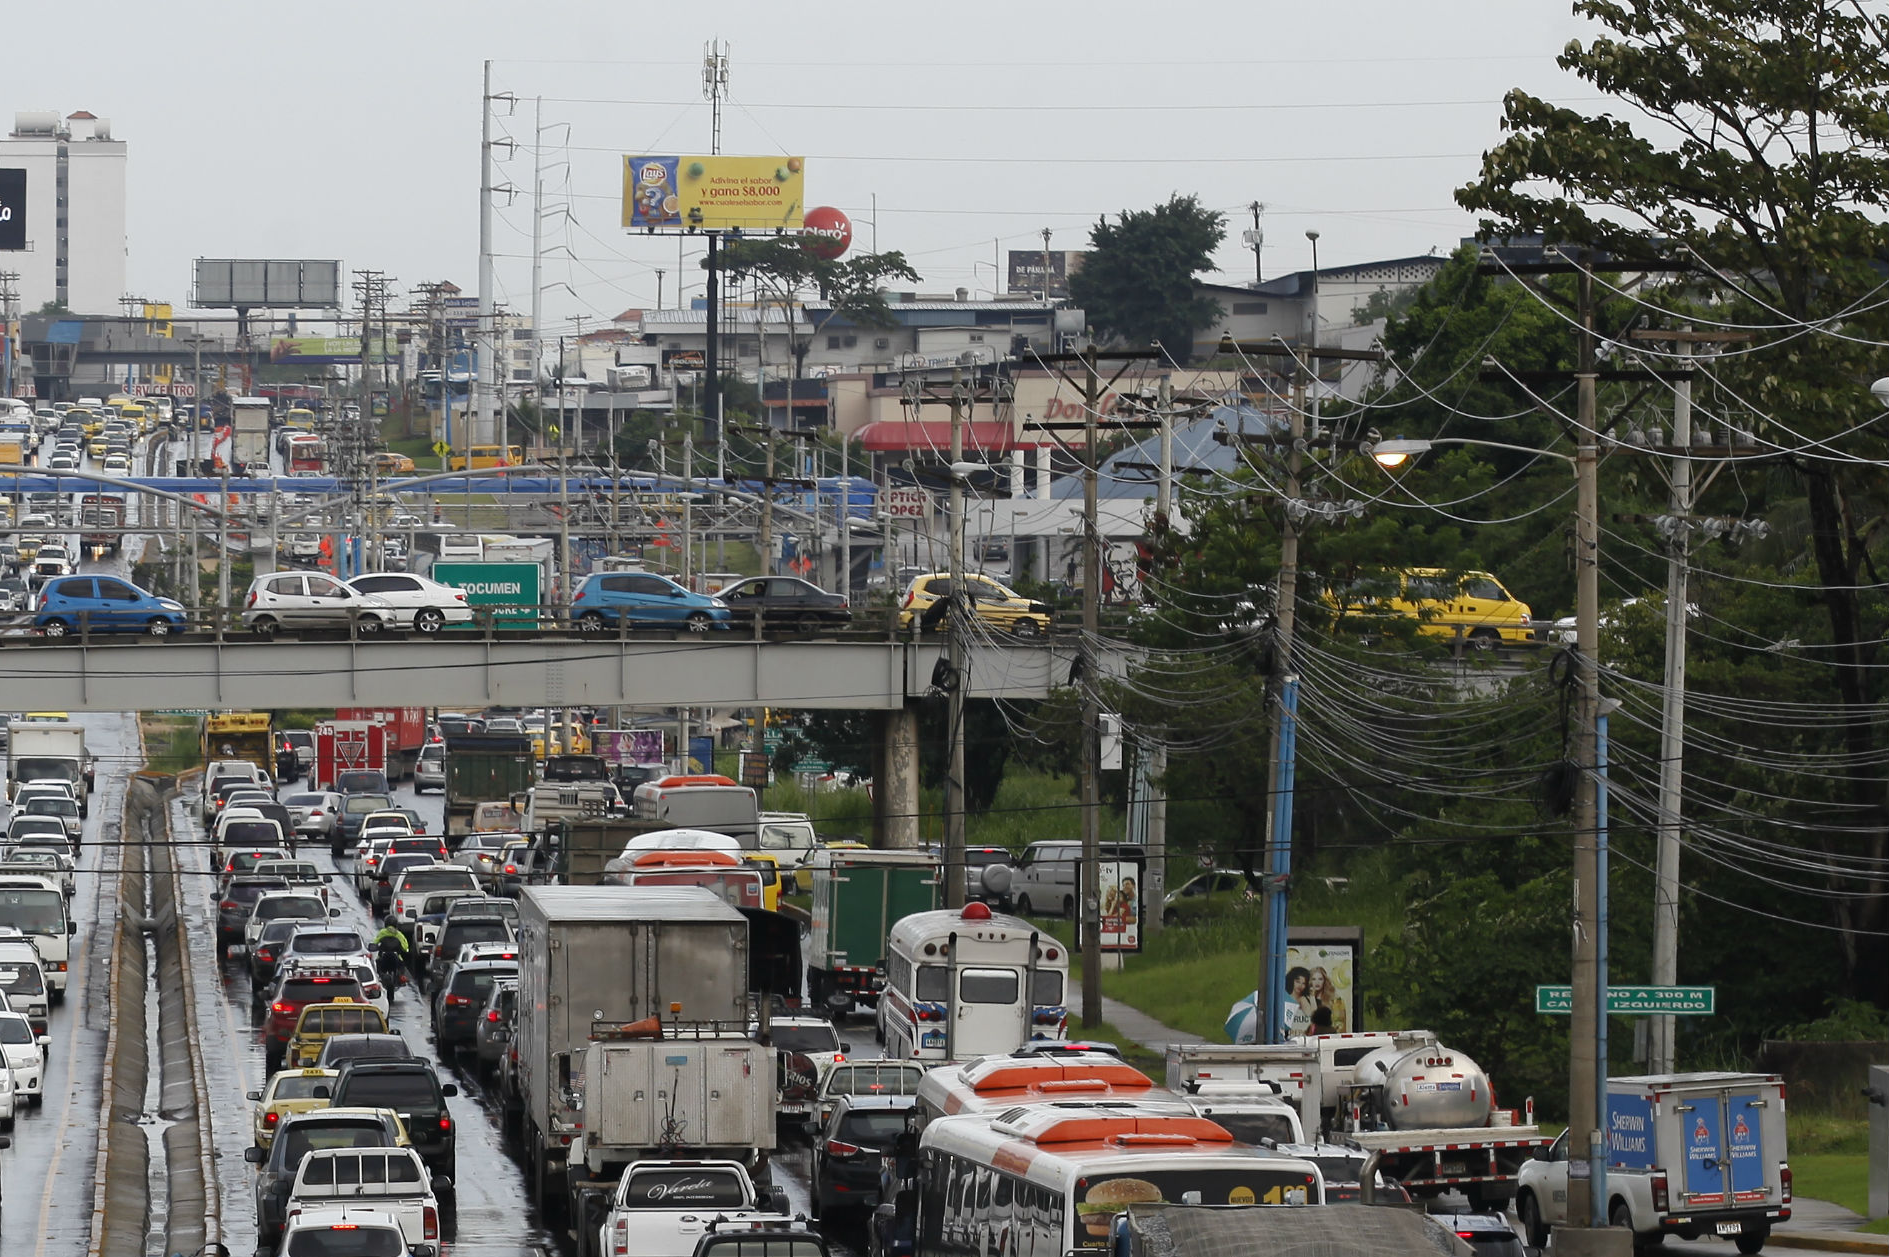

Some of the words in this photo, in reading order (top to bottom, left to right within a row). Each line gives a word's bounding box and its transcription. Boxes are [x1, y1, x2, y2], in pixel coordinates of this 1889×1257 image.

[710, 177, 736, 185] Adivina
[701, 189, 708, 198] y
[710, 188, 740, 198] gana
[742, 186, 780, 197] $8,000
[317, 726, 333, 736] 245
[1550, 990, 1629, 1000] RENO
[1636, 991, 1647, 999] A
[1654, 990, 1683, 999] 300
[1690, 990, 1702, 999] M
[1614, 1001, 1706, 1010] IZQUIERDO
[1612, 1111, 1645, 1131] SHERWIN
[1611, 1135, 1646, 1153] WILLIAMS
[1730, 1144, 1756, 1152] SHERWIN
[1689, 1152, 1717, 1160] WILLIAMS
